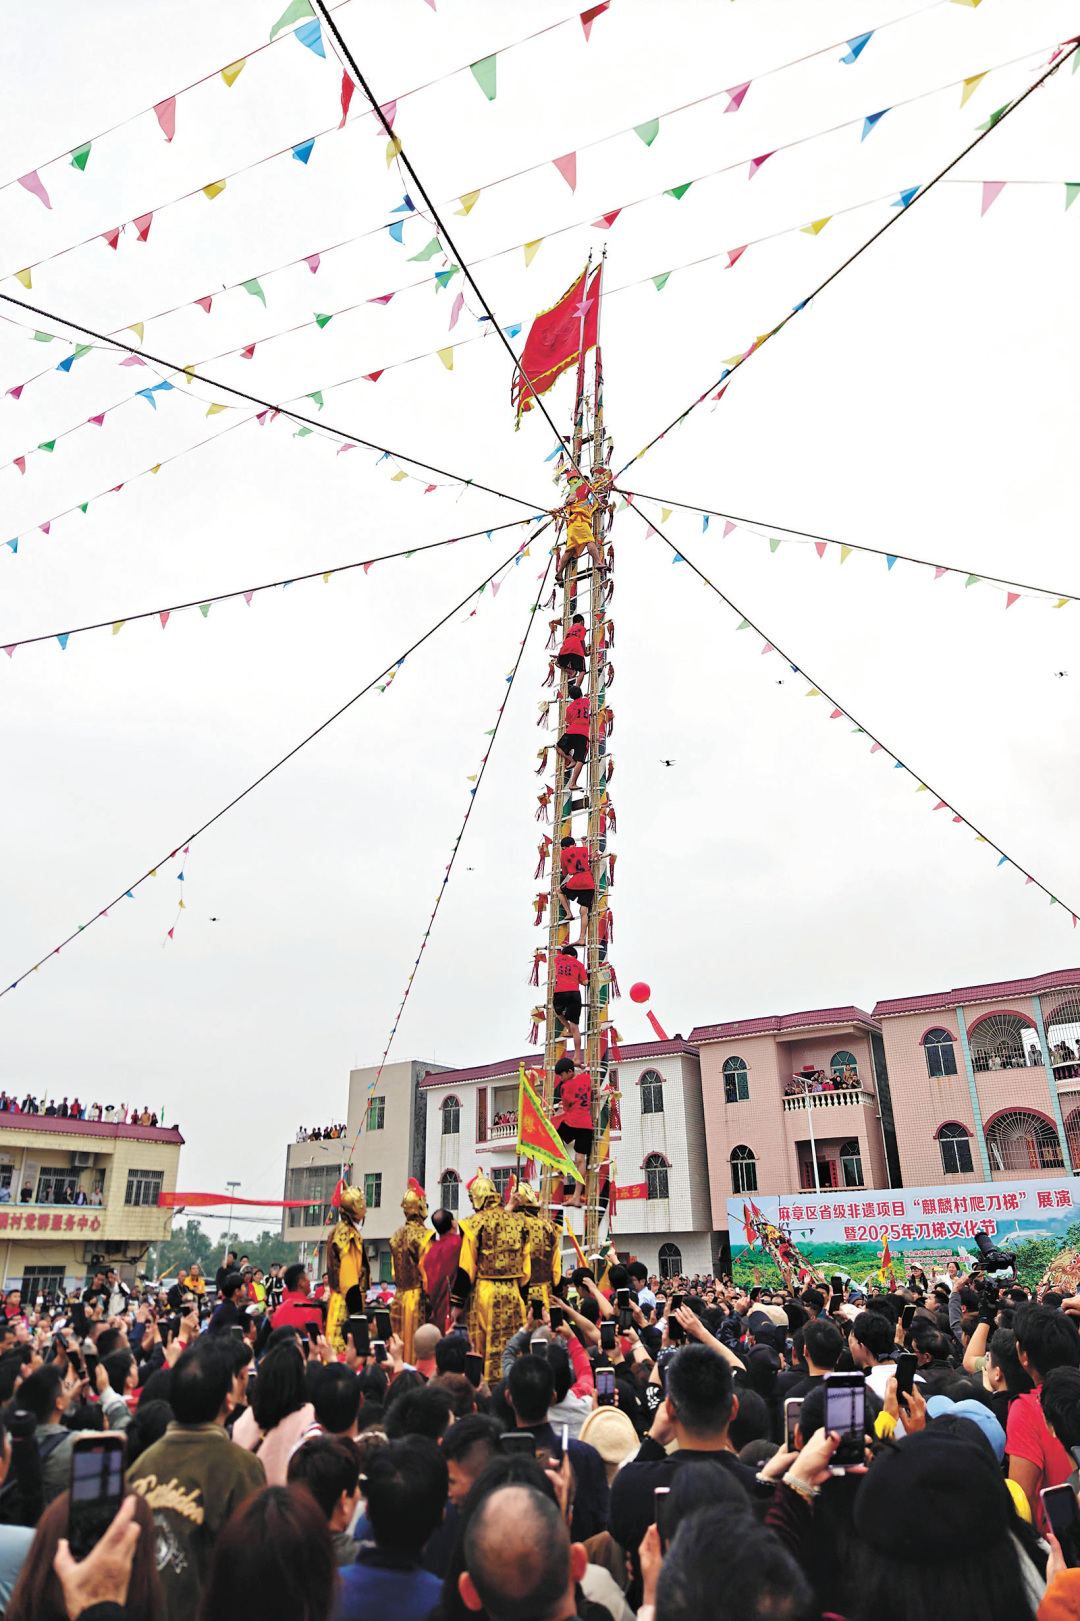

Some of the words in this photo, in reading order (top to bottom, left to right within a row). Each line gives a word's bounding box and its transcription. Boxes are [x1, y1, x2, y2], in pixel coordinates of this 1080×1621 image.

[844, 1218, 997, 1242] 暨2025年刀梯文化节
